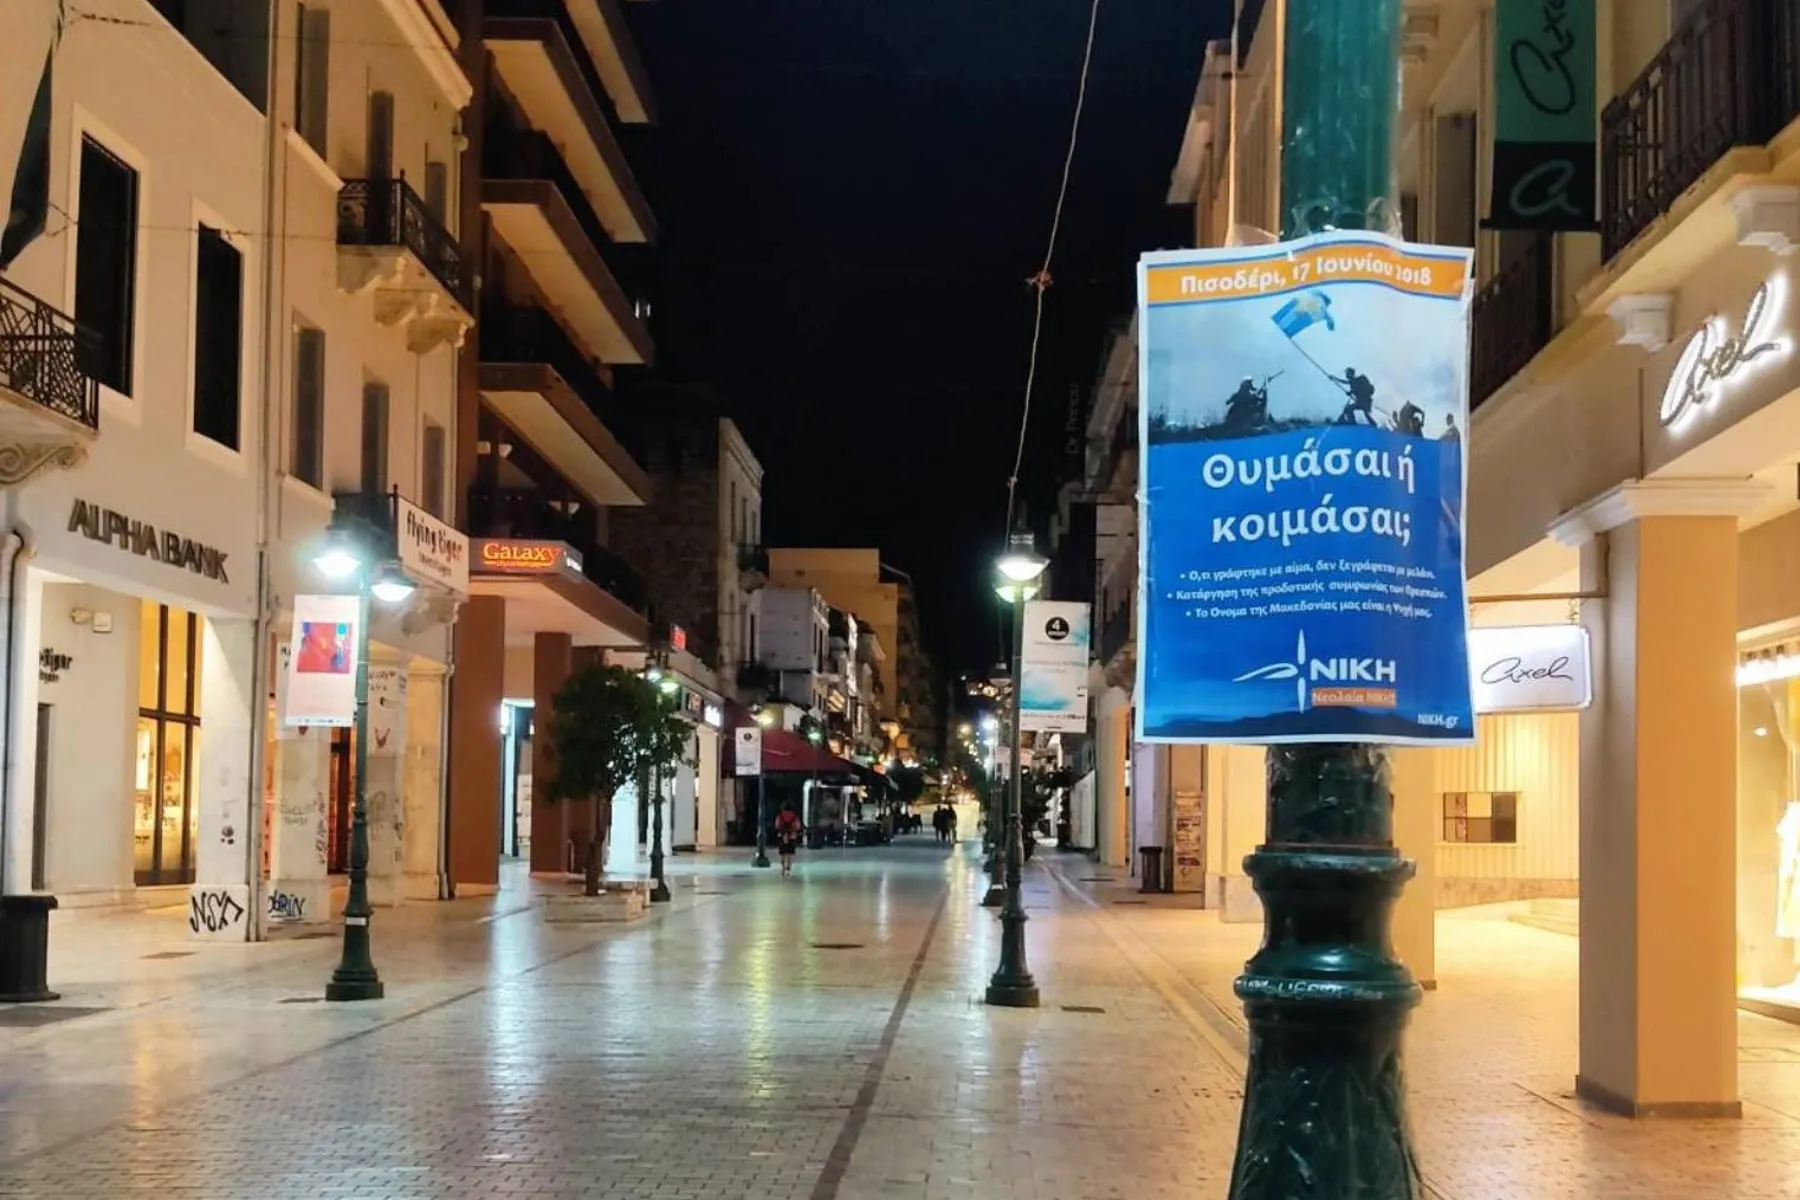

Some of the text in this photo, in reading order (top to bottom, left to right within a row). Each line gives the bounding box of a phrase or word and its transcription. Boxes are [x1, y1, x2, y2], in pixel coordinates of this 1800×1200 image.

[1181, 255, 1432, 294] Πισοδέρι, 17 Ιουνίου 2018
[1202, 437, 1415, 494] Θυμάσαι ή
[1211, 493, 1411, 547] κοιμάσαι;
[67, 498, 229, 584] ALPHA BANK
[1269, 565, 1283, 577] με
[1315, 559, 1337, 572] δεν
[1176, 587, 1239, 601] Κατάργηση
[1240, 586, 1259, 598] της
[1250, 605, 1268, 618] της
[1269, 599, 1338, 614] Μακεδονίας
[1339, 601, 1361, 614] μας
[1310, 657, 1396, 683] ΝΙΚΗ
